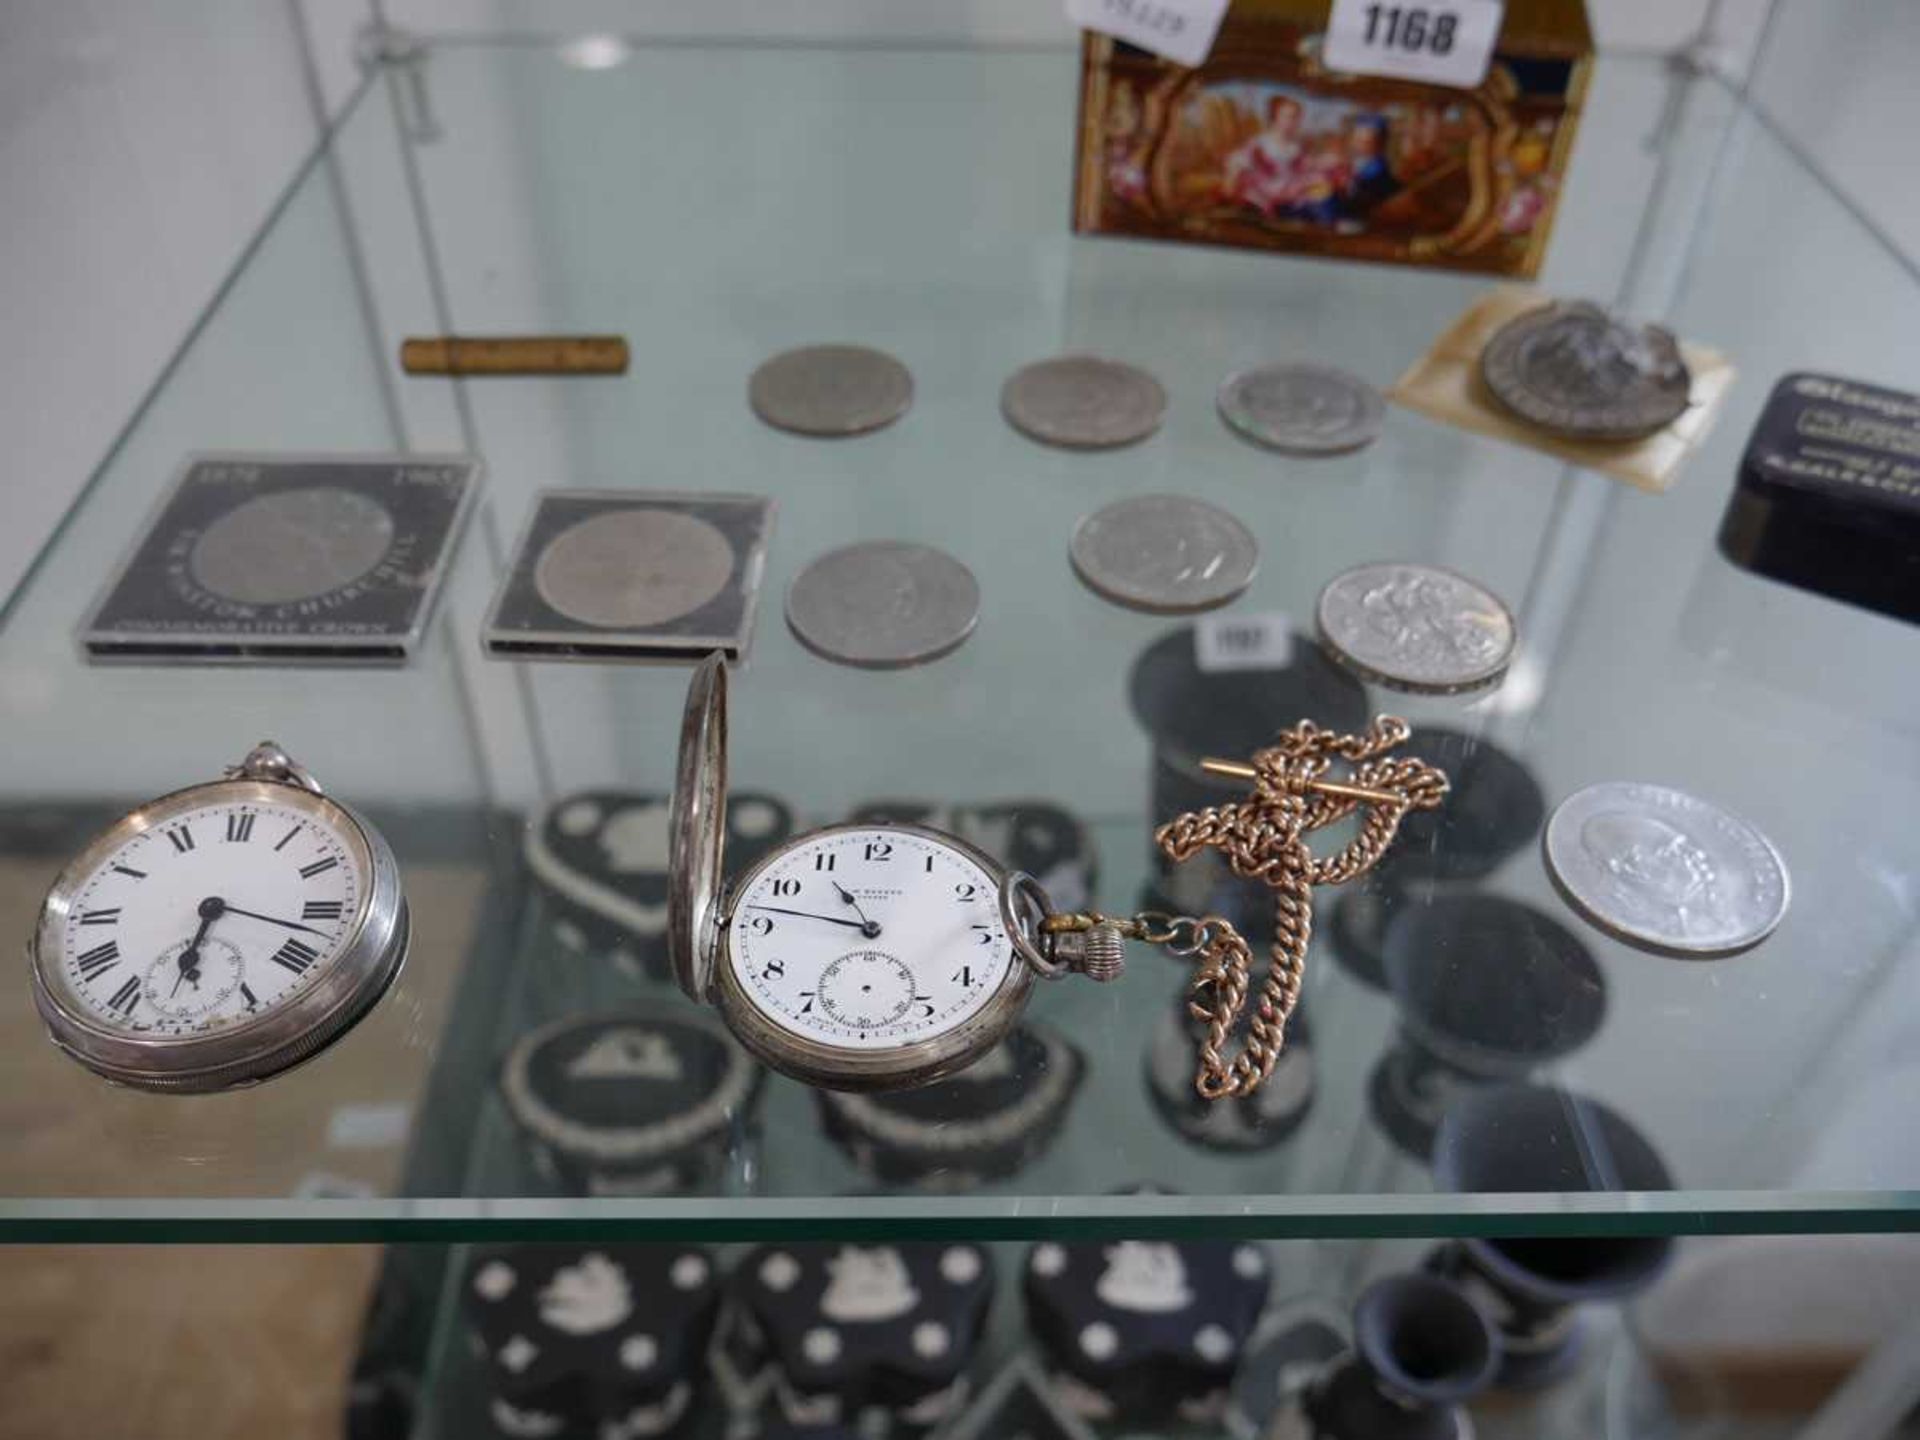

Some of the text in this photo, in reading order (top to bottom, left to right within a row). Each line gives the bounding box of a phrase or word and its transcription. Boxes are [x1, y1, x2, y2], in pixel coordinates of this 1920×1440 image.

[1364, 4, 1458, 56] 1168
[815, 853, 836, 871] 11
[864, 843, 893, 861] 12
[299, 855, 339, 879] II
[925, 855, 934, 873] 1
[772, 878, 801, 897] 10
[955, 884, 976, 902] 2
[302, 901, 344, 920] III
[752, 916, 774, 936] 9
[269, 936, 321, 975] IIII
[762, 959, 785, 981] 8
[951, 966, 976, 987] 4
[799, 991, 817, 1014] 7
[914, 996, 936, 1017] 5
